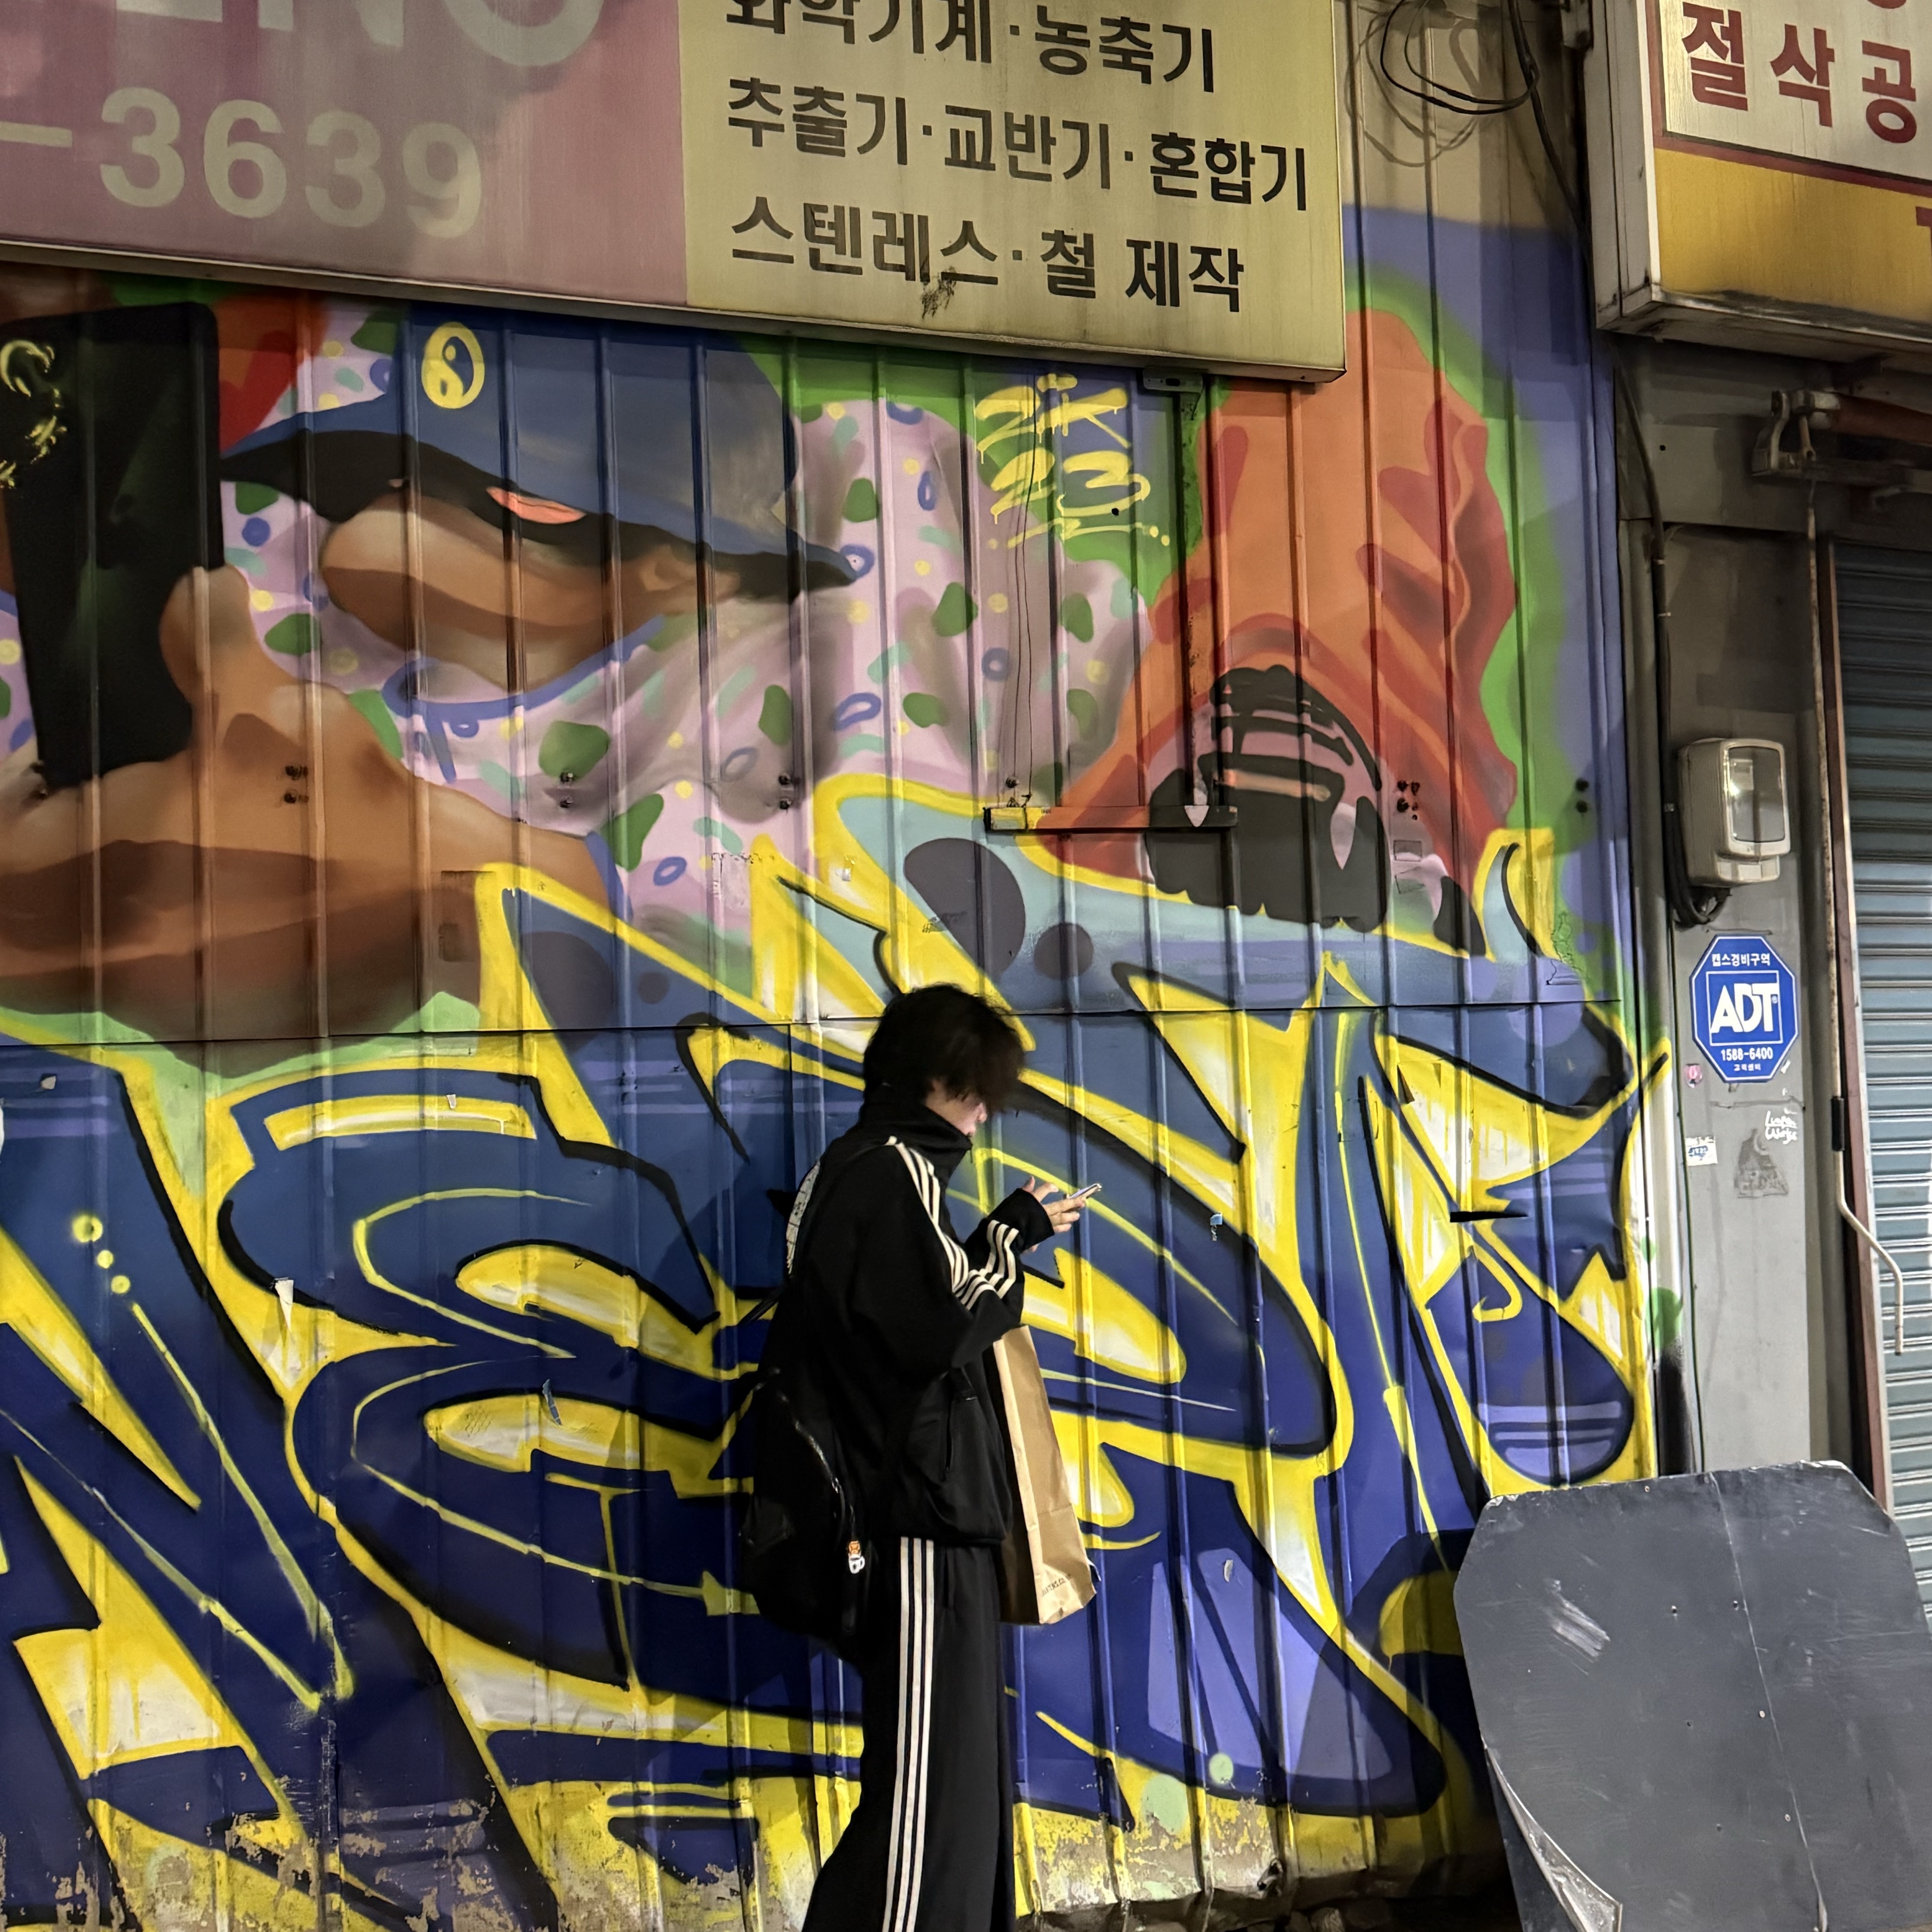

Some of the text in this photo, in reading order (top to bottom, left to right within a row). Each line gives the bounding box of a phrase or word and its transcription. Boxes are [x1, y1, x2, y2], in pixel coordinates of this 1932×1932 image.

[1125, 238, 1244, 313] 제작
[1710, 982, 1779, 1033] ADT
[1720, 1047, 1773, 1061] 1588-6400
